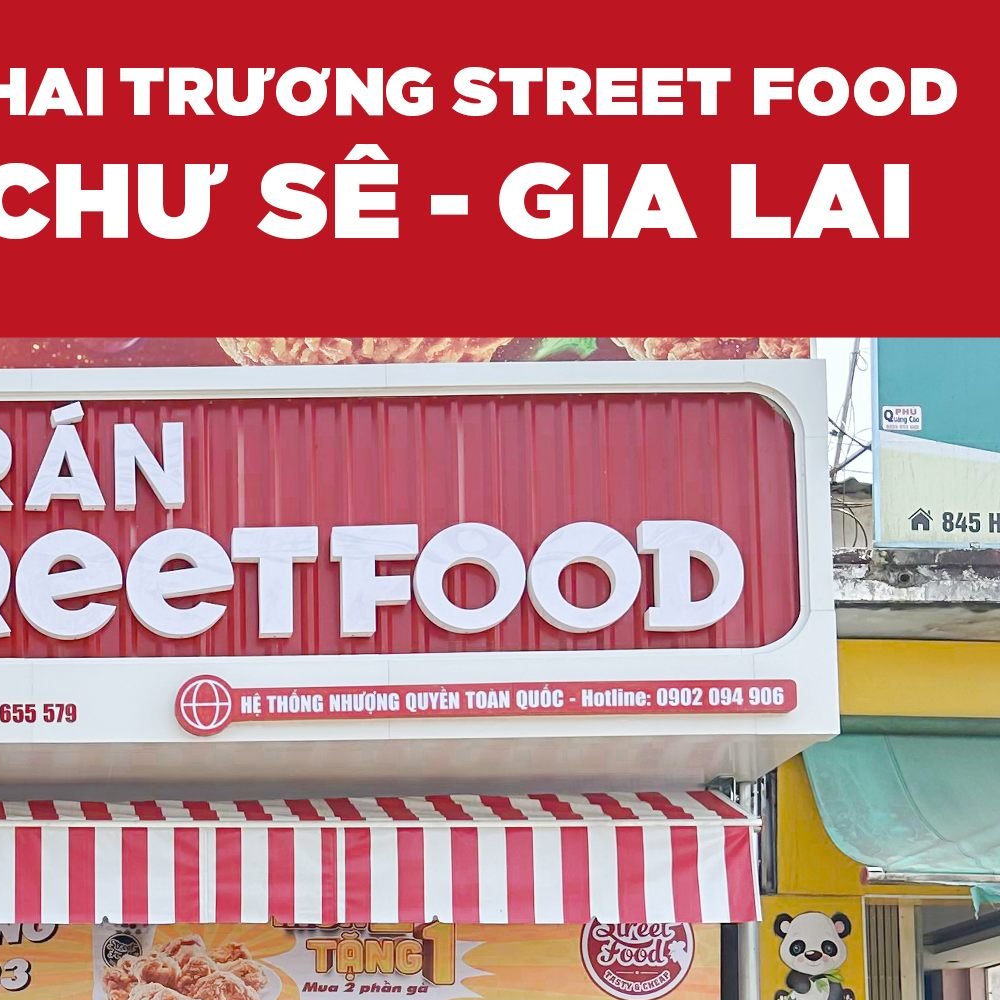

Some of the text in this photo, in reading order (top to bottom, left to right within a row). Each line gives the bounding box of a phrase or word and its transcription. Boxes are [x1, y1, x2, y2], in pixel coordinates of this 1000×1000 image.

[942, 511, 981, 533] 845
[241, 692, 261, 716] HỆ
[266, 689, 324, 713] THỐNG
[329, 690, 400, 715] NHƯỢNG
[405, 686, 460, 713] QUYỀN
[465, 689, 510, 711] TOÀN
[515, 684, 564, 710] QUỐC
[581, 688, 652, 709] Hotline:
[656, 687, 703, 706] 0902
[708, 686, 744, 706] 094
[748, 686, 785, 706] 906
[0, 703, 37, 724] 655
[43, 703, 77, 724] 579
[305, 920, 457, 986] TẶNG 1
[601, 938, 666, 964] Food
[301, 981, 339, 993] Mua
[343, 981, 356, 993] 2
[405, 981, 429, 995] gà
[605, 970, 670, 991] TASTY & CHEAP
